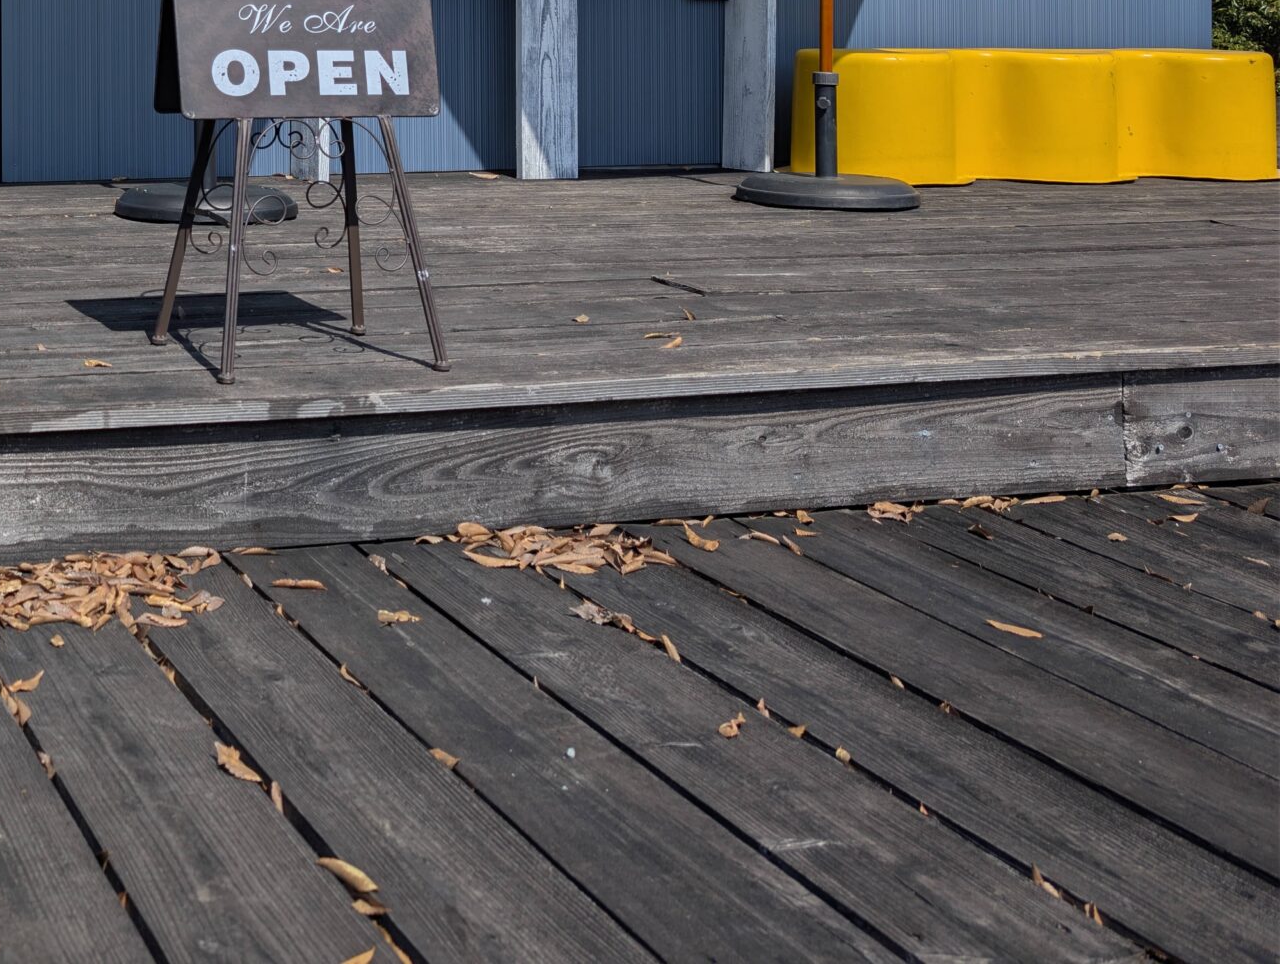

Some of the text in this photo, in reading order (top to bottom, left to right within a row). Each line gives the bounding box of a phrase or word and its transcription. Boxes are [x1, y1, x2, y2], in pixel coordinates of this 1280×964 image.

[238, 3, 377, 35] We Are
[211, 49, 410, 97] OPEN
